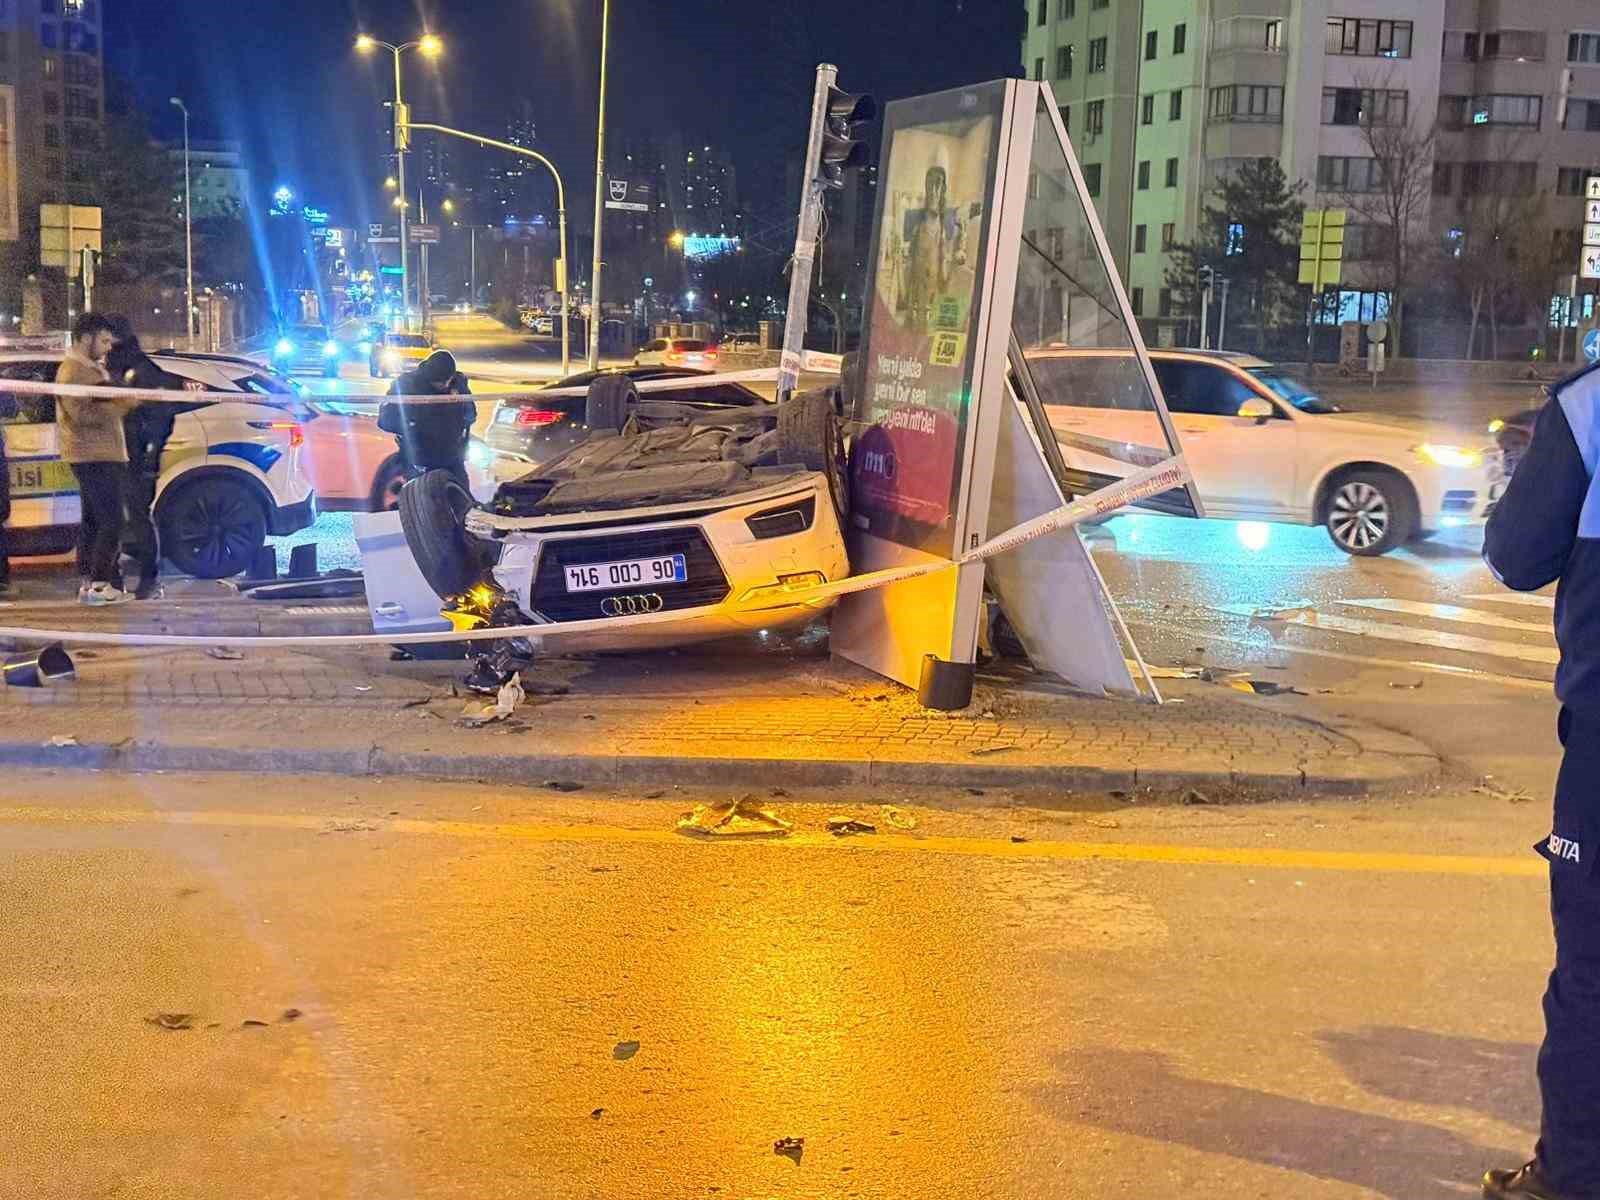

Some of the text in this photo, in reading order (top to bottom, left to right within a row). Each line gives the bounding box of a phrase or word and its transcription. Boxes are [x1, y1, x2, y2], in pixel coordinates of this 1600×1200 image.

[11, 466, 42, 487] isi
[570, 559, 674, 588] 06 CDD 914
